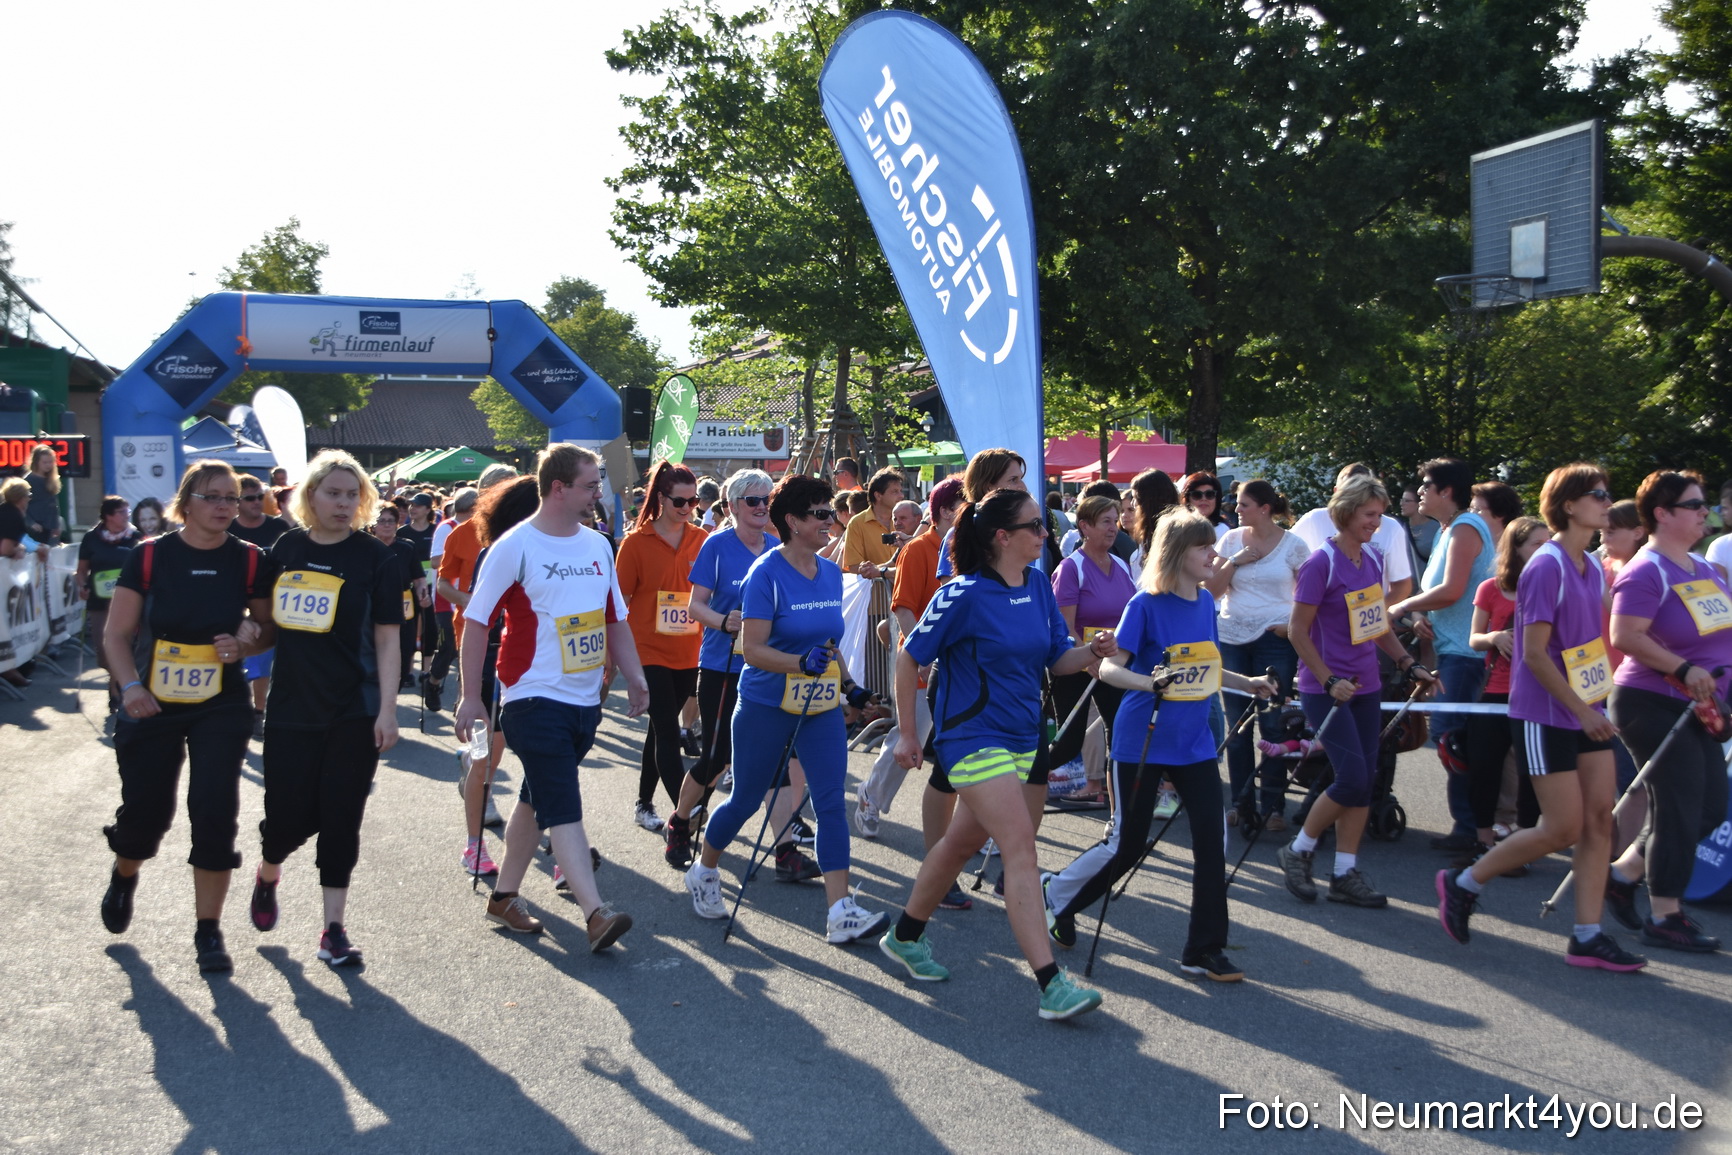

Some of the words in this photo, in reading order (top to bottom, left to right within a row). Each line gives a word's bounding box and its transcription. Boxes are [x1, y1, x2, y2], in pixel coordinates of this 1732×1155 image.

[368, 320, 399, 328] Fischer
[345, 334, 436, 352] firmenlauf
[166, 363, 218, 374] Fischer
[0, 438, 85, 467] 00021
[542, 560, 604, 581] Xplus1
[279, 591, 330, 616] 1198
[1009, 595, 1032, 605] hummel
[1697, 598, 1729, 617] 303
[1358, 605, 1382, 628] 292
[567, 631, 604, 657] 1509
[159, 665, 217, 687] 1187
[1579, 663, 1606, 689] 306
[791, 682, 836, 701] 1325
